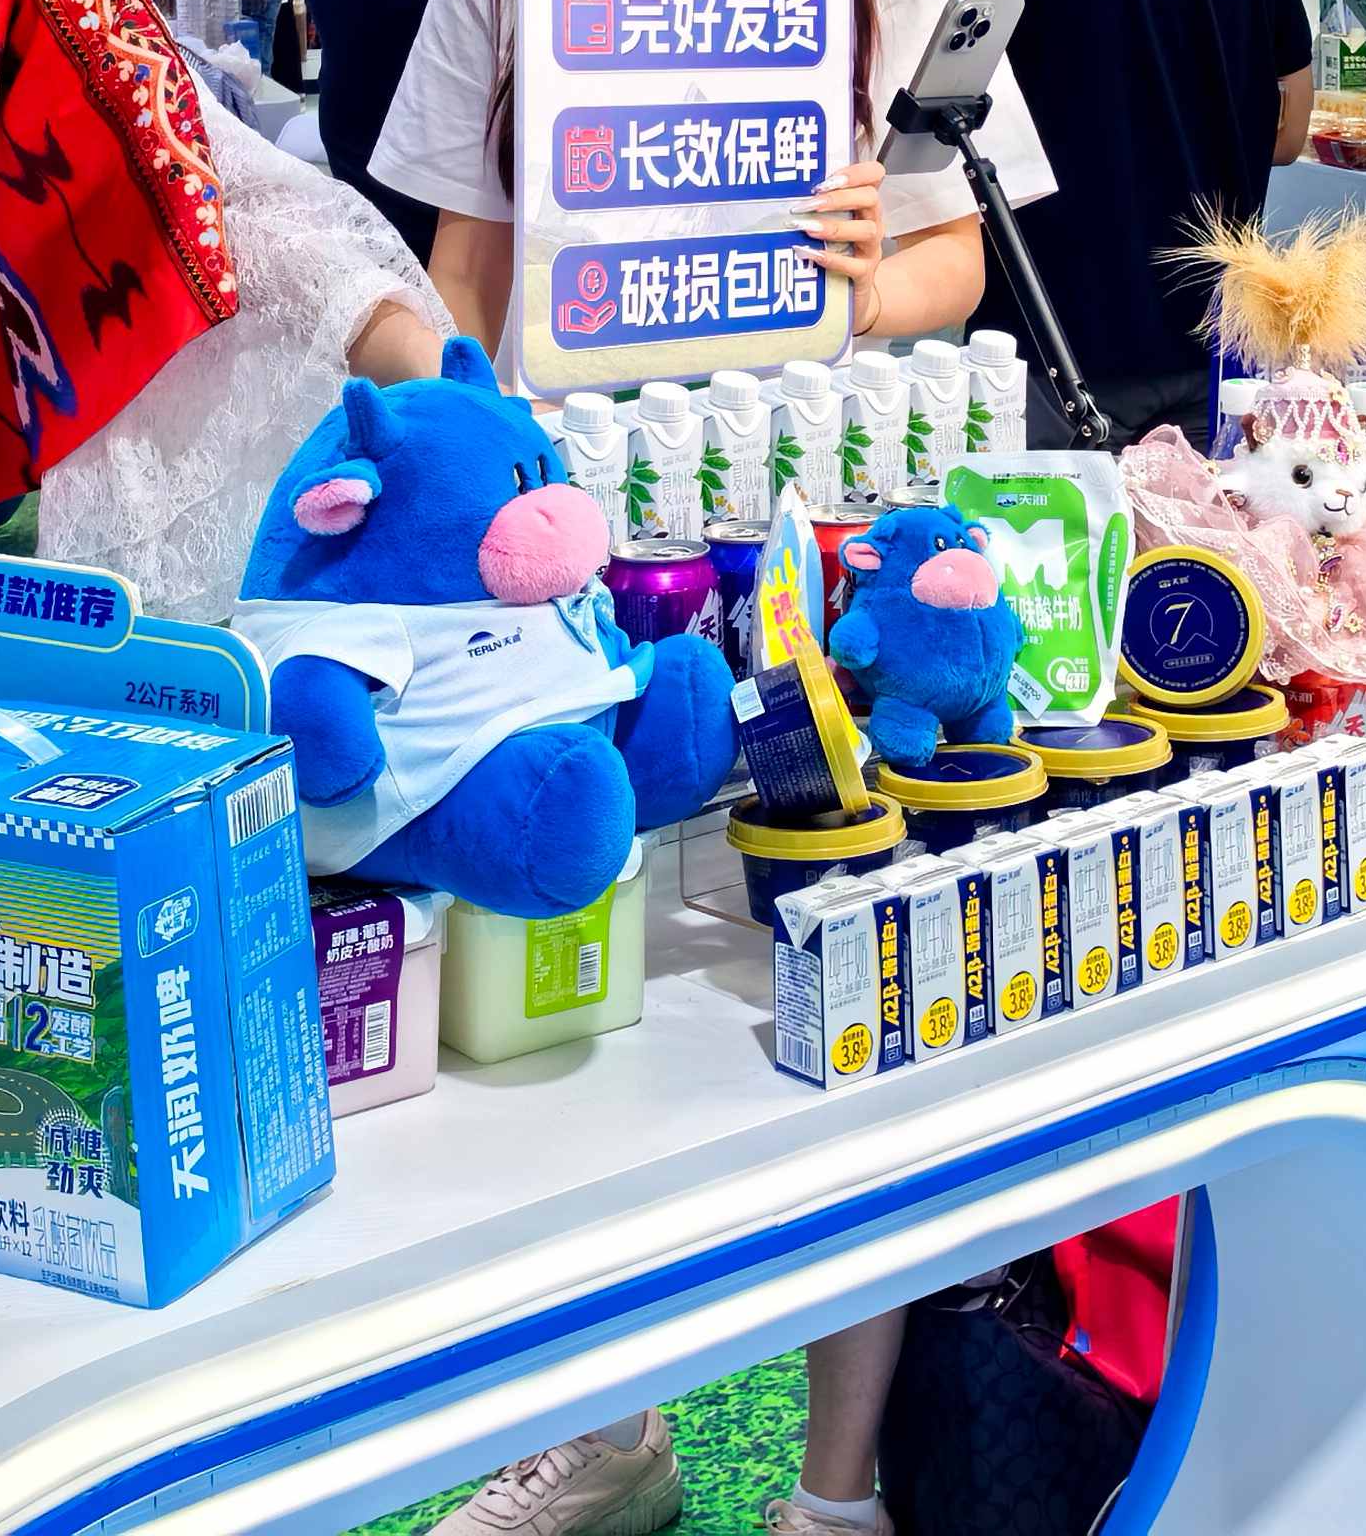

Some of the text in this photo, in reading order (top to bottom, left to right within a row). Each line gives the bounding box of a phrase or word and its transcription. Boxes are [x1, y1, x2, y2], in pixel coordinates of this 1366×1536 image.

[620, 116, 820, 191] 长效保鲜
[620, 245, 819, 329] 破损包赔
[1019, 493, 1048, 506] 天润
[1164, 599, 1196, 645] 7
[124, 680, 222, 720] 2公斤系列
[326, 935, 394, 964] 奶皮子酸奶
[841, 1041, 860, 1068] 3.8
[156, 963, 211, 1200] 天润奶啤
[43, 1124, 103, 1161] 减糖
[45, 1161, 105, 1199] 劲爽
